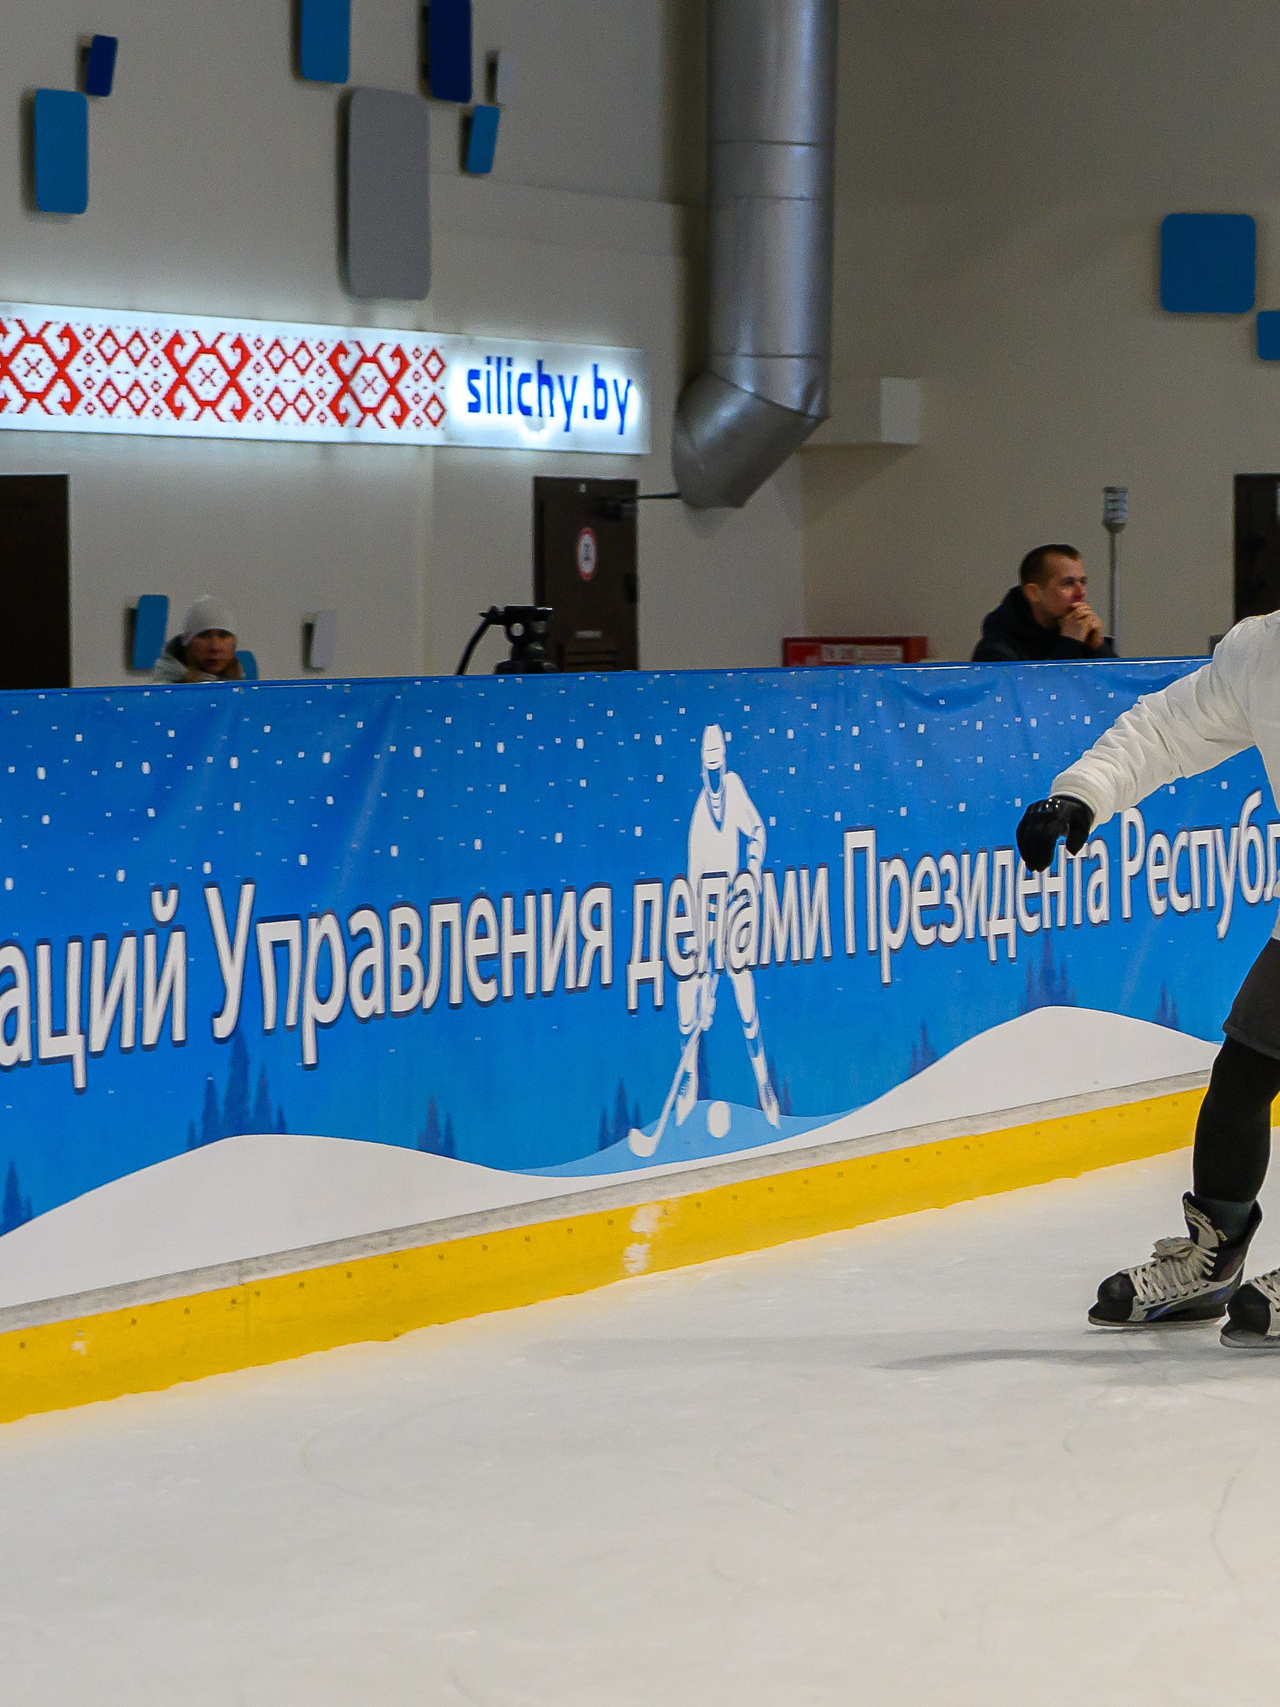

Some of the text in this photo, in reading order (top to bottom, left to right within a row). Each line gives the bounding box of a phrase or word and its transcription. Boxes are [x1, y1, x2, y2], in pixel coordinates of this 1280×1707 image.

[467, 355, 632, 435] silichy.by
[204, 880, 612, 1066] Управления
[627, 867, 832, 1012] делами
[843, 826, 1110, 986] Президента
